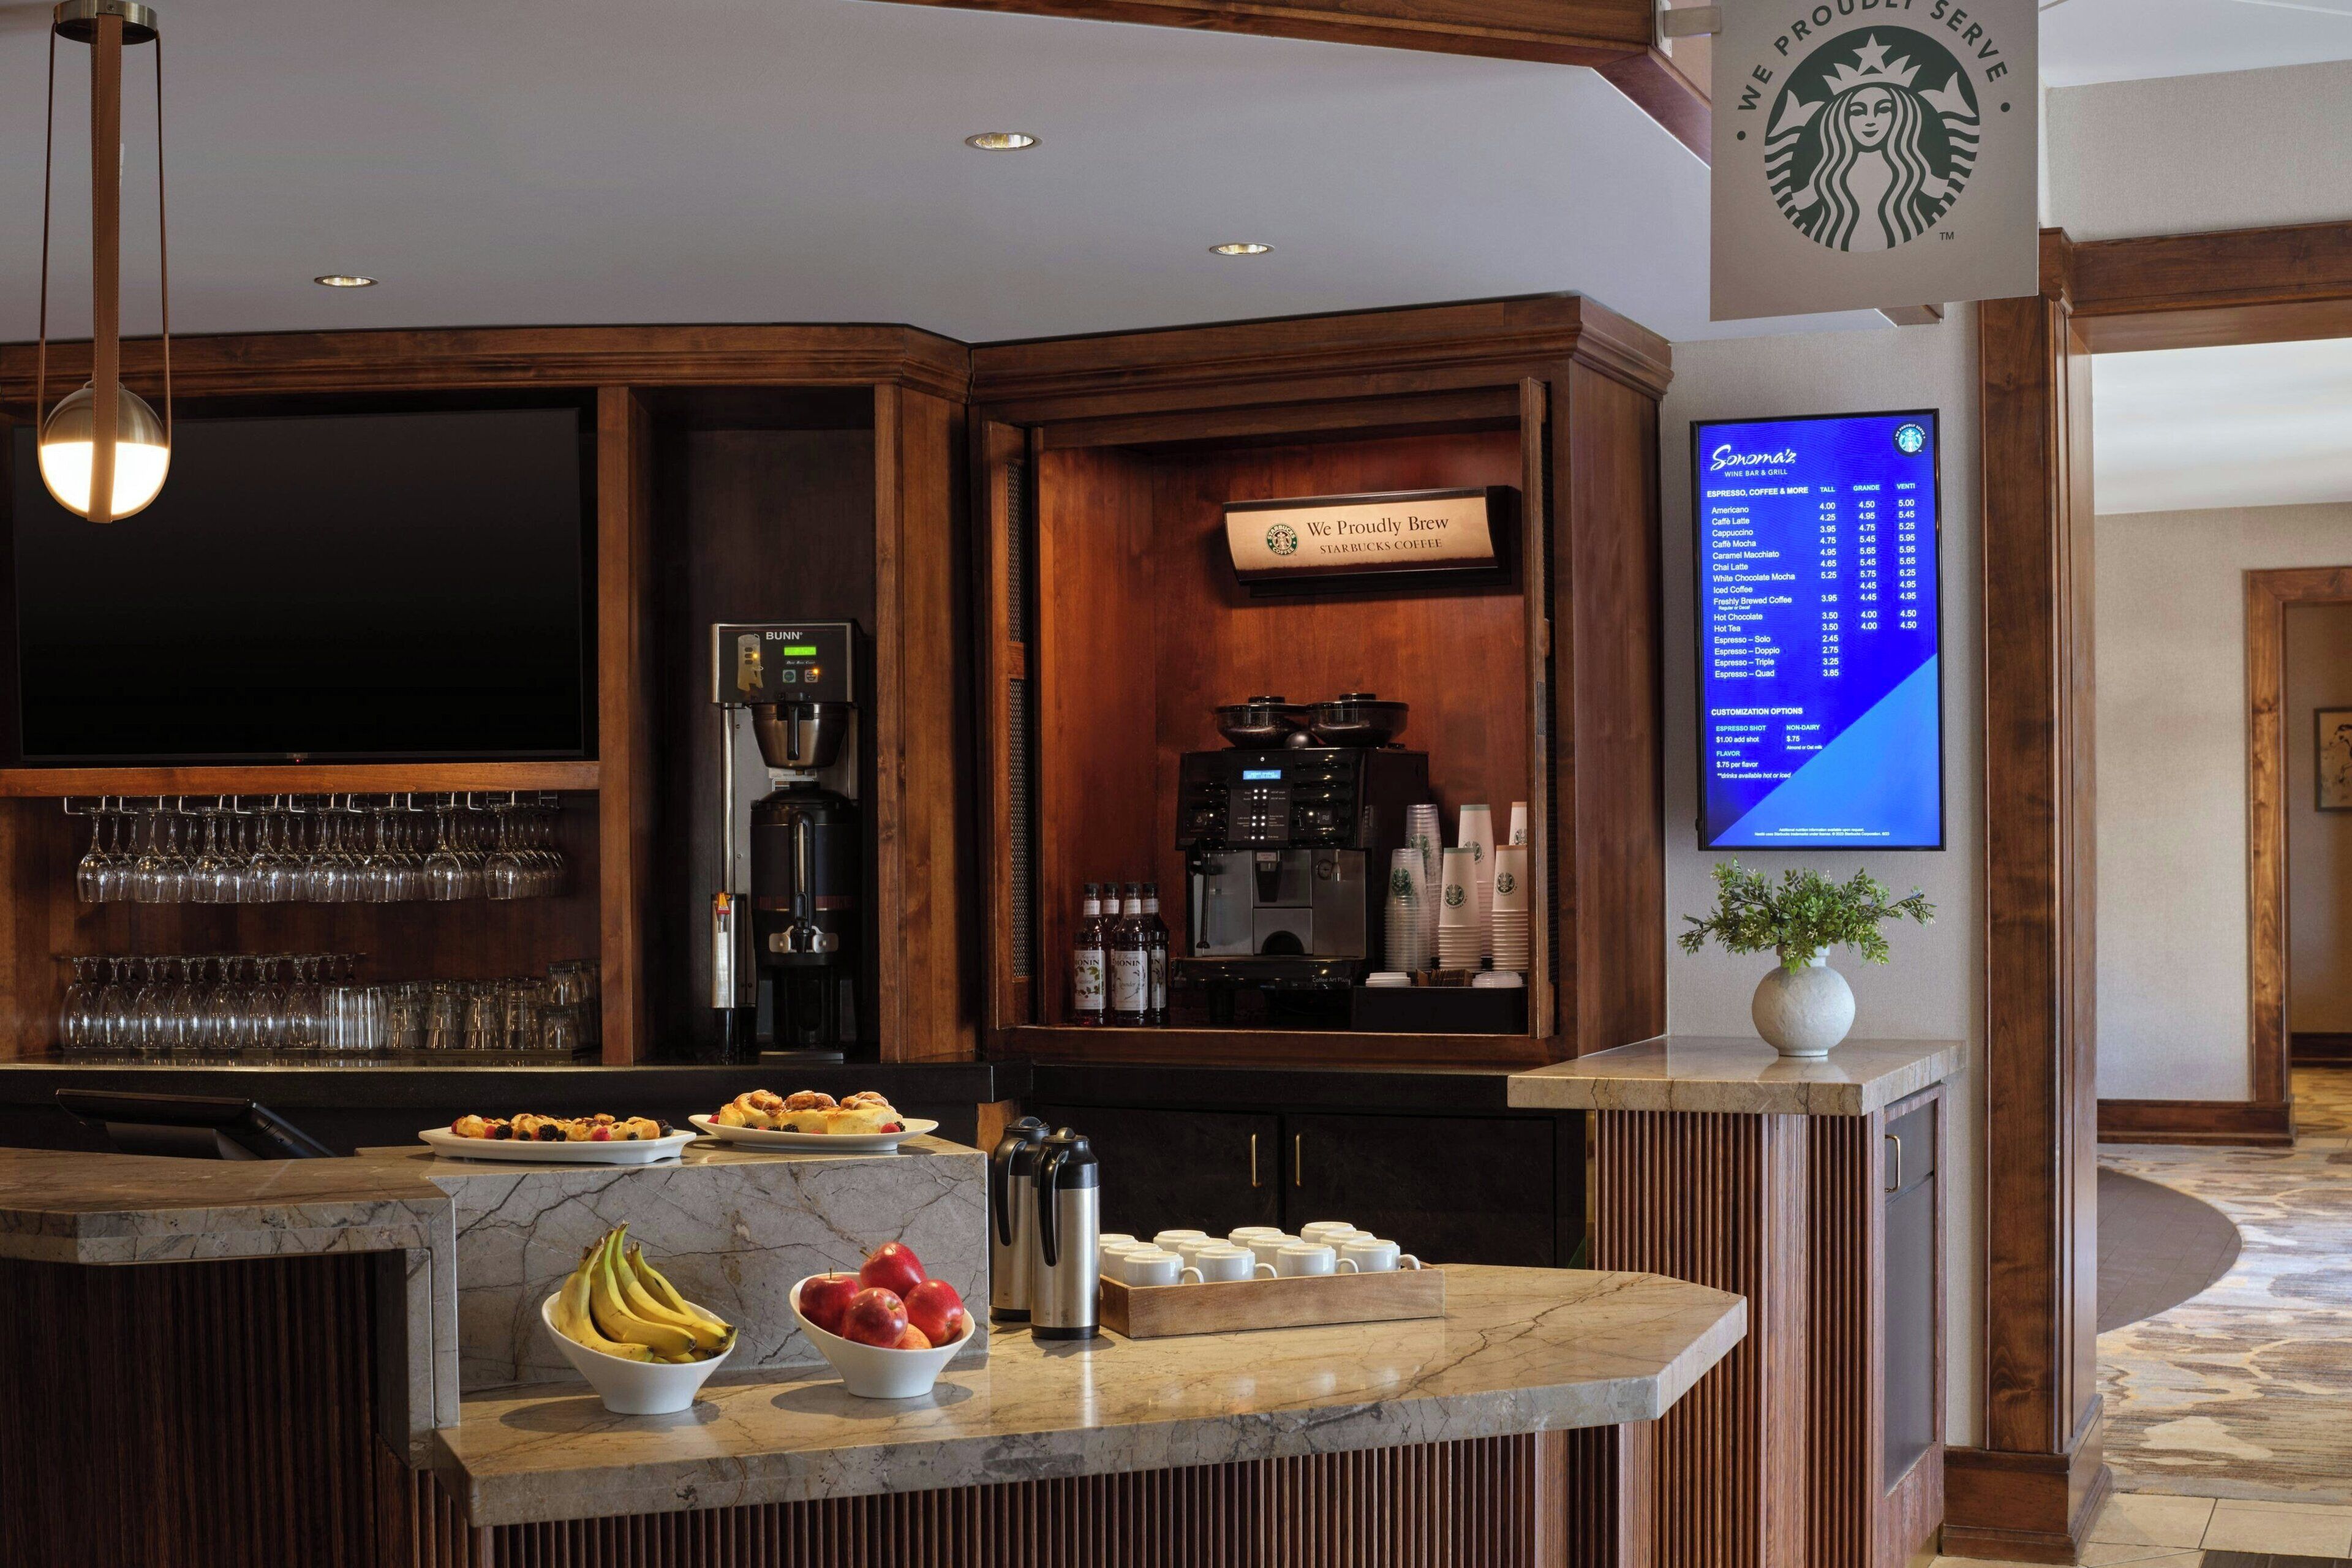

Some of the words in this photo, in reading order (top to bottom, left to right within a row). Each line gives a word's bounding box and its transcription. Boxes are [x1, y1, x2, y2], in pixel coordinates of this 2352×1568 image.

[1738, 65, 1773, 111] WE
[1930, 0, 2008, 82] SERVE
[1307, 521, 1332, 537] We
[1336, 518, 1401, 537] Proudly
[1408, 515, 1449, 531] Brew
[1712, 529, 1753, 538] Cappuccino
[1320, 541, 1391, 554] STARBUCKS
[1394, 538, 1442, 549] COFFEE
[1755, 647, 1780, 655] Doppio
